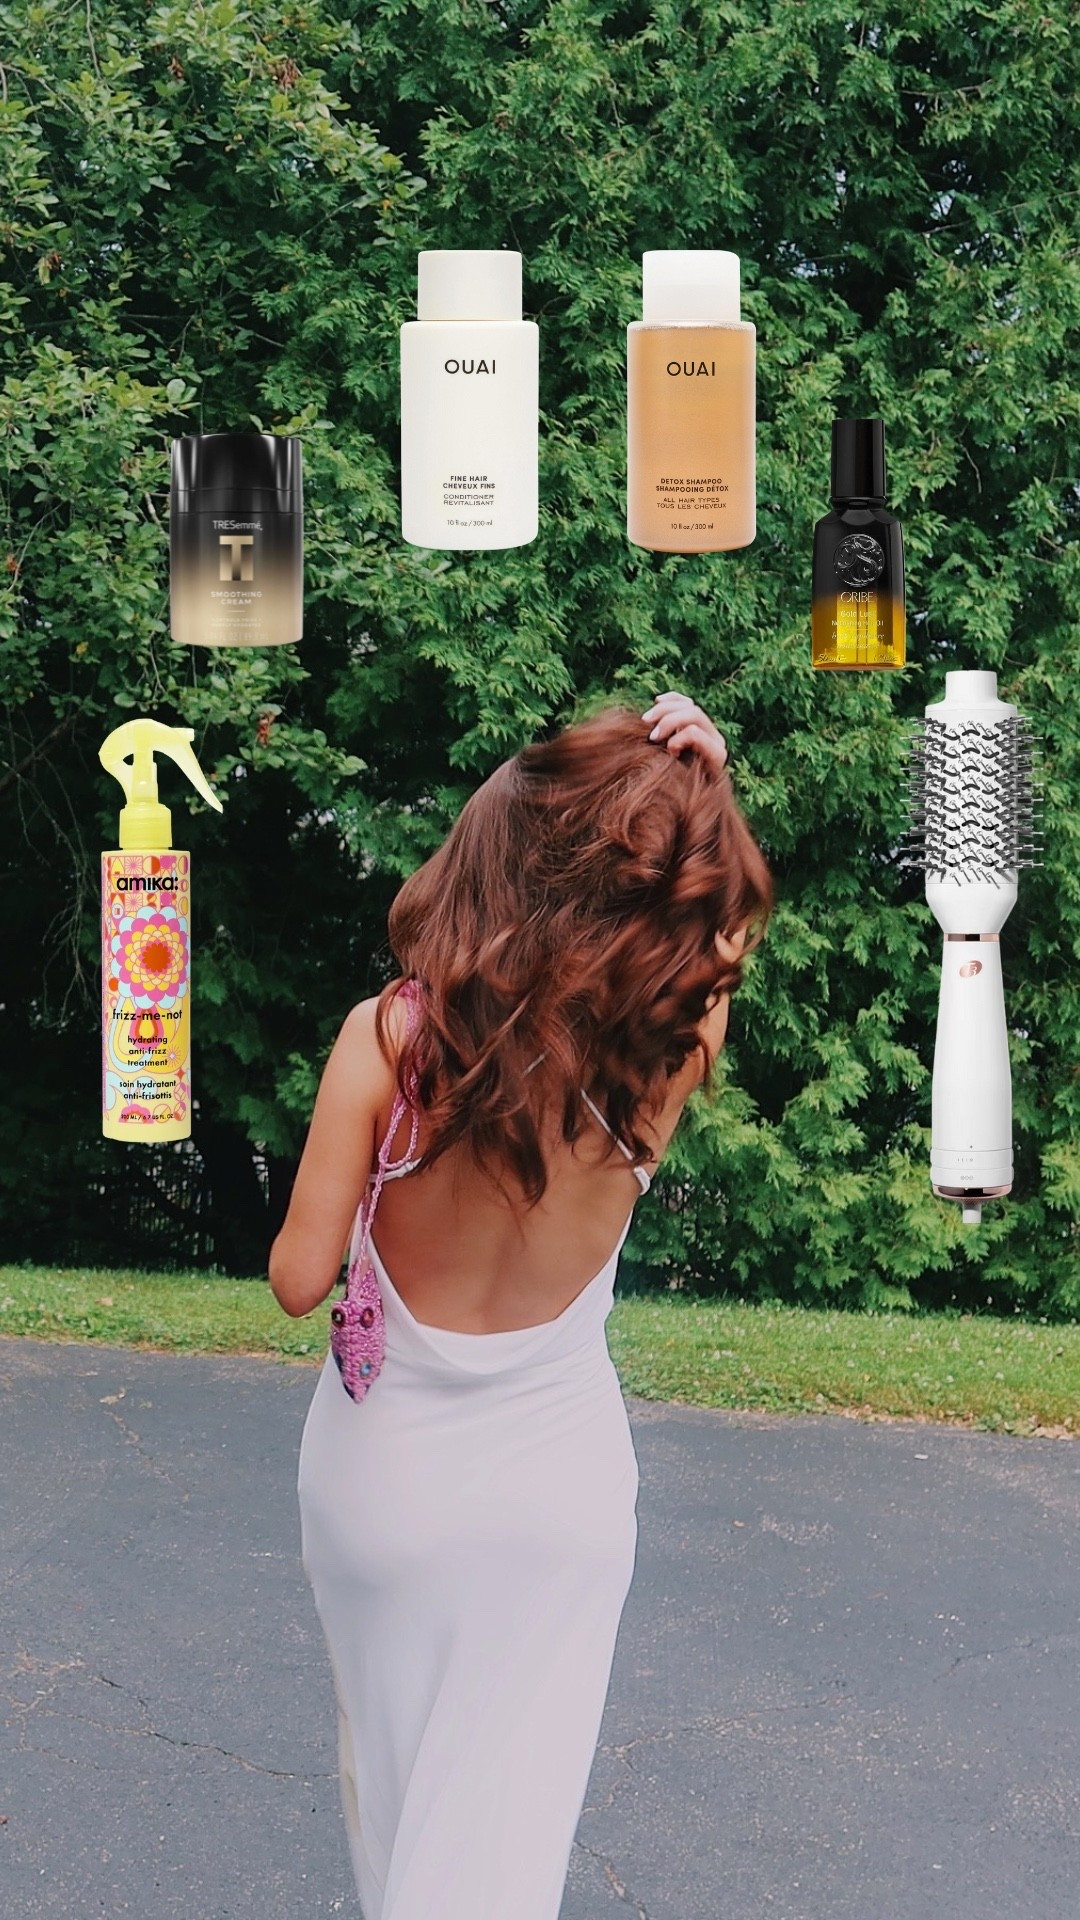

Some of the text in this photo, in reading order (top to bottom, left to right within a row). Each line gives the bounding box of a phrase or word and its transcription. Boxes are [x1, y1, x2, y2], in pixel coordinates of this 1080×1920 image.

[444, 359, 496, 374] OUAI
[666, 361, 715, 377] OUAI
[655, 484, 729, 493] SHAMPOOING DÉTOX
[840, 591, 875, 603] ORIBE
[112, 1008, 183, 1021] frizz-me-not
[127, 1035, 168, 1045] hydrating
[128, 1047, 167, 1055] anti-frizz
[127, 1059, 168, 1067] treatment
[119, 1080, 177, 1090] soin hydratant
[123, 1092, 173, 1100] anti-frisottis
